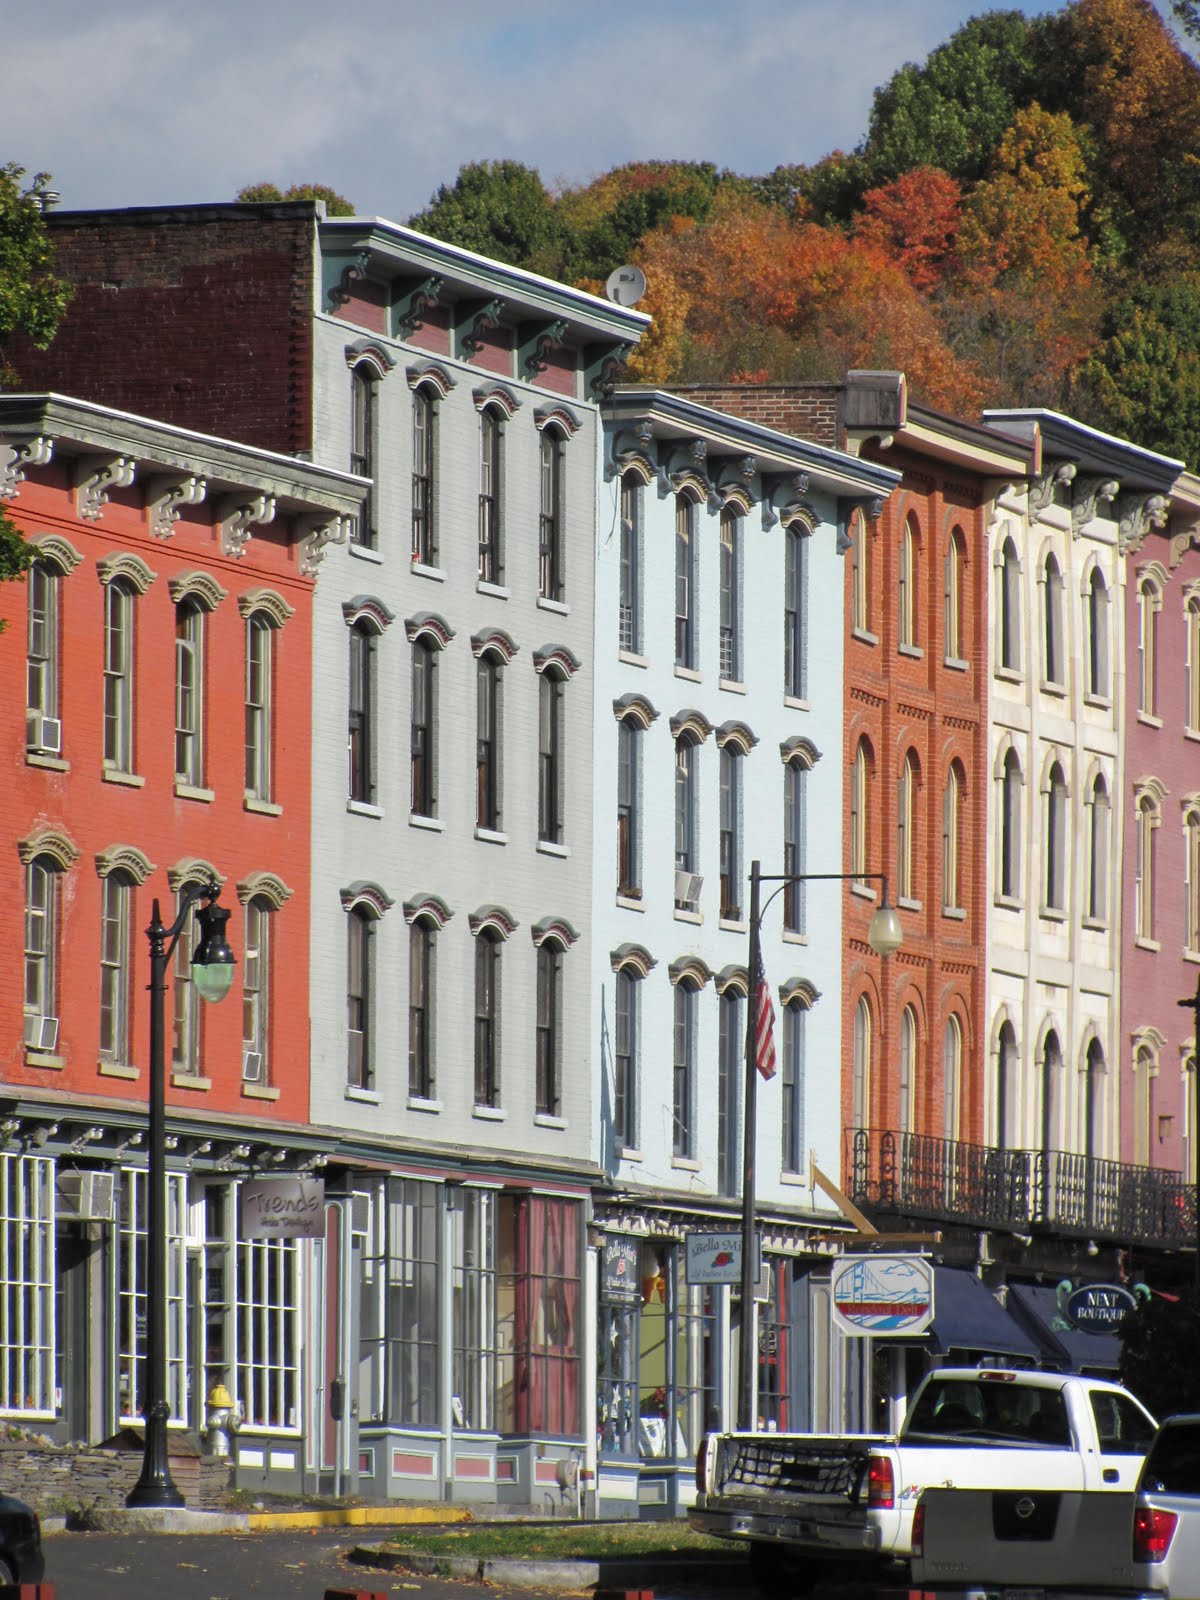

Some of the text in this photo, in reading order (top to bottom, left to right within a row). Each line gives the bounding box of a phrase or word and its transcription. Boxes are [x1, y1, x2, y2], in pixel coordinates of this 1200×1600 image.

[248, 1182, 319, 1213] Trends
[692, 1237, 742, 1257] Bella Mi
[1087, 1291, 1119, 1307] NEXT
[896, 1304, 918, 1315] Deli
